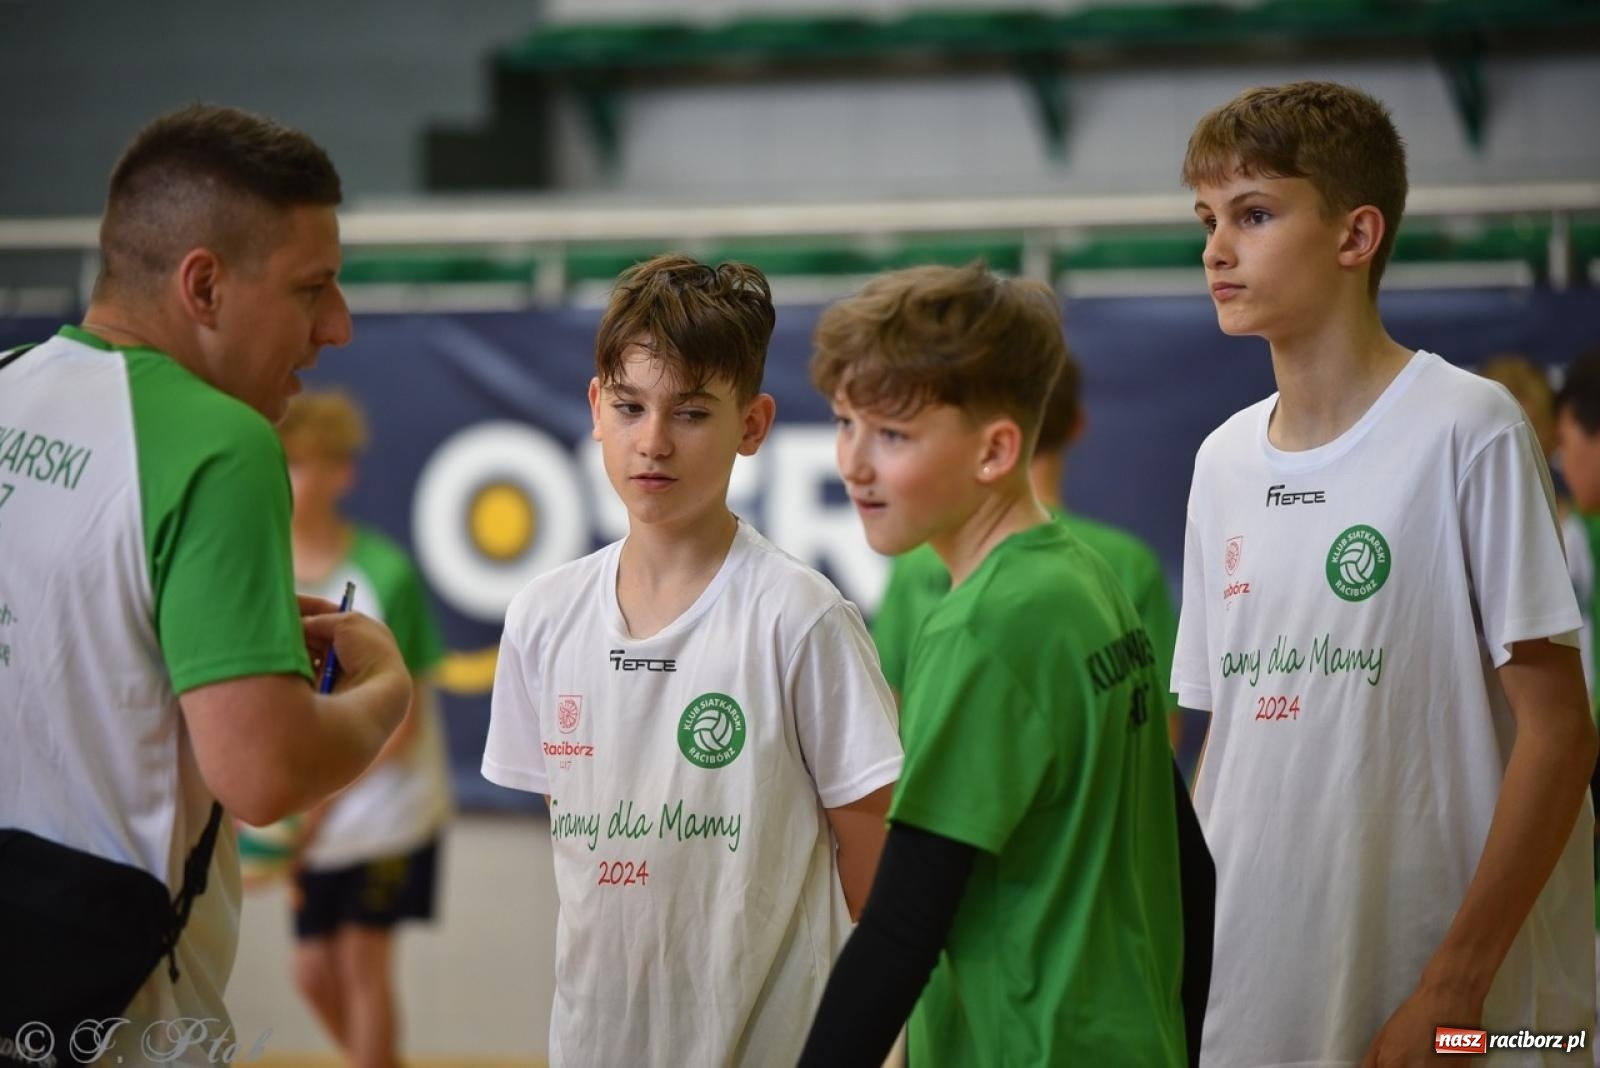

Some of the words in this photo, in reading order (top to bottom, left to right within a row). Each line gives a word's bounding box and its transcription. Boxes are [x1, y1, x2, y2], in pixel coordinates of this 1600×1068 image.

[1331, 538, 1349, 563] KLUB
[1347, 530, 1386, 564] SIATKARSKI
[1335, 579, 1378, 597] RACIBÓRZ
[1267, 635, 1305, 675] dla
[1309, 633, 1383, 687] Mamy
[683, 705, 702, 731] KLUB
[700, 698, 742, 731] SIATKARSKI
[1255, 695, 1301, 721] 2024
[688, 746, 736, 764] RACIBÓRZ
[608, 800, 653, 839] dla
[659, 799, 742, 852] Mamy
[598, 860, 650, 886] 2024
